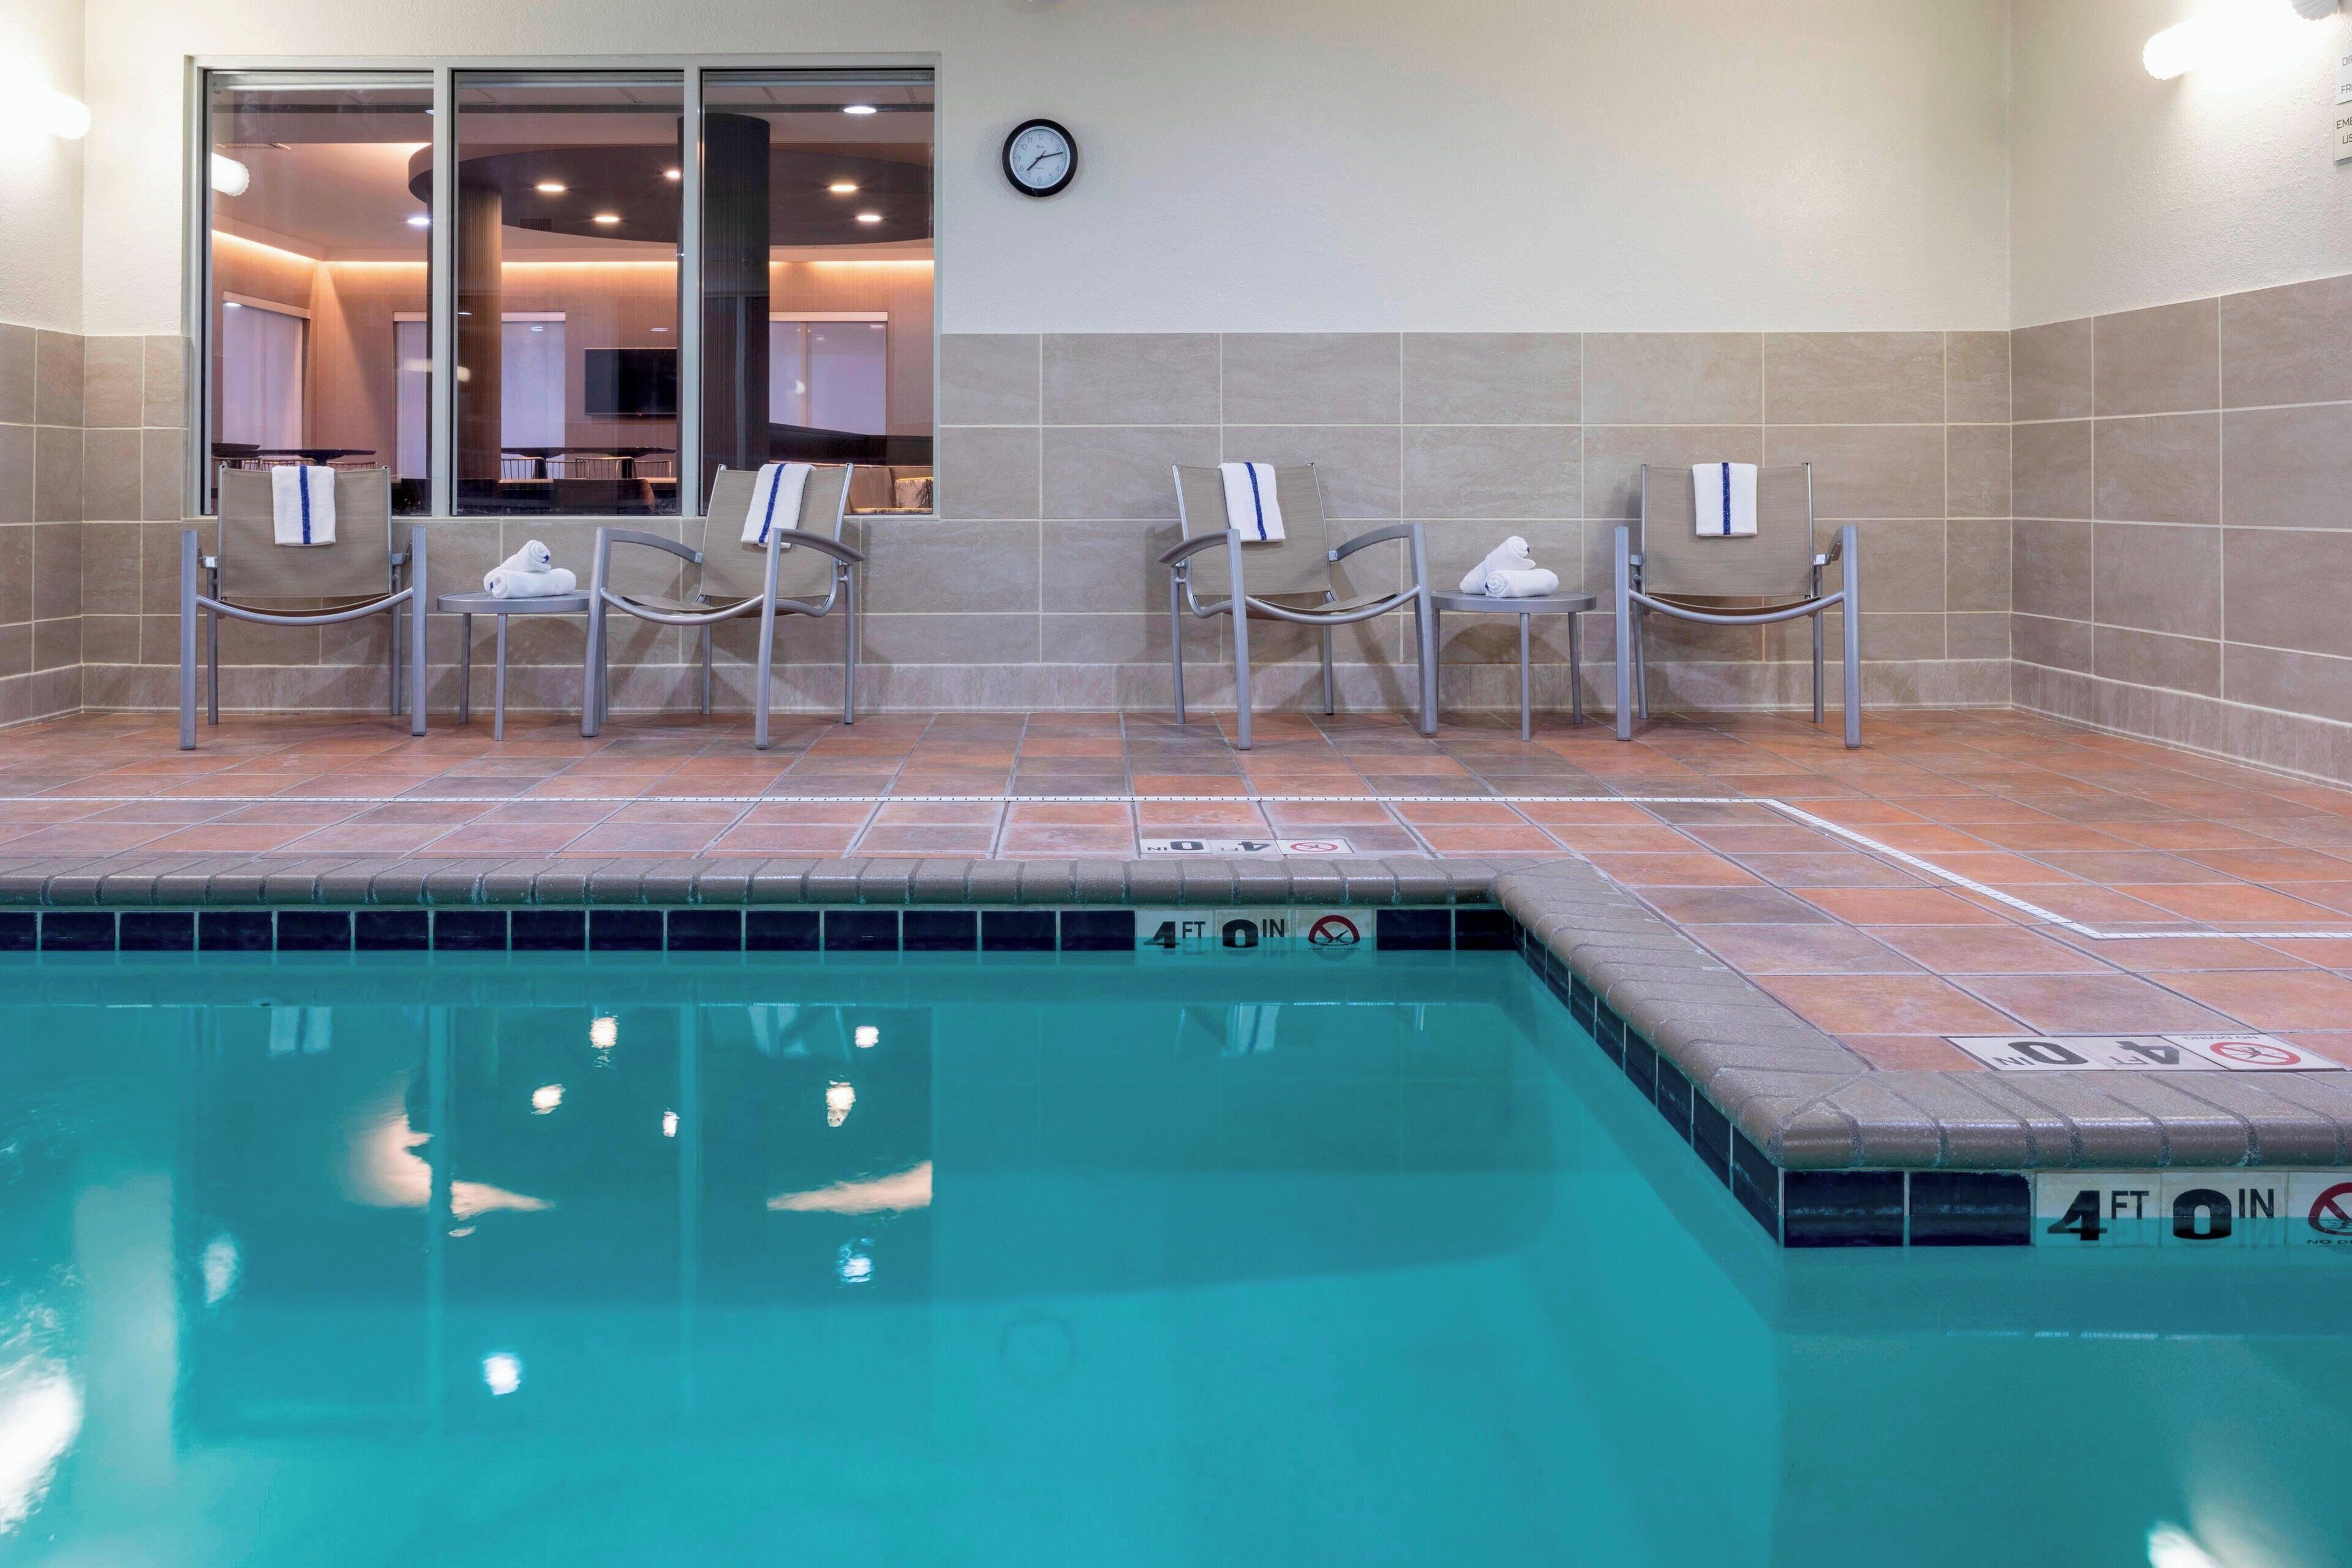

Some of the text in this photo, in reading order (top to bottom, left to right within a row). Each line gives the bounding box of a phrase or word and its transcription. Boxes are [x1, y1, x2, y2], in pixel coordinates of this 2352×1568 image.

[2341, 83, 2352, 94] FR
[1170, 841, 1204, 850] 0
[1238, 841, 1271, 851] 4
[1143, 919, 1284, 948] 4 FT 0 IN
[1992, 1041, 2179, 1065] 4 FT 0 IN
[2047, 1188, 2274, 1240] 4 FT 0 IN
